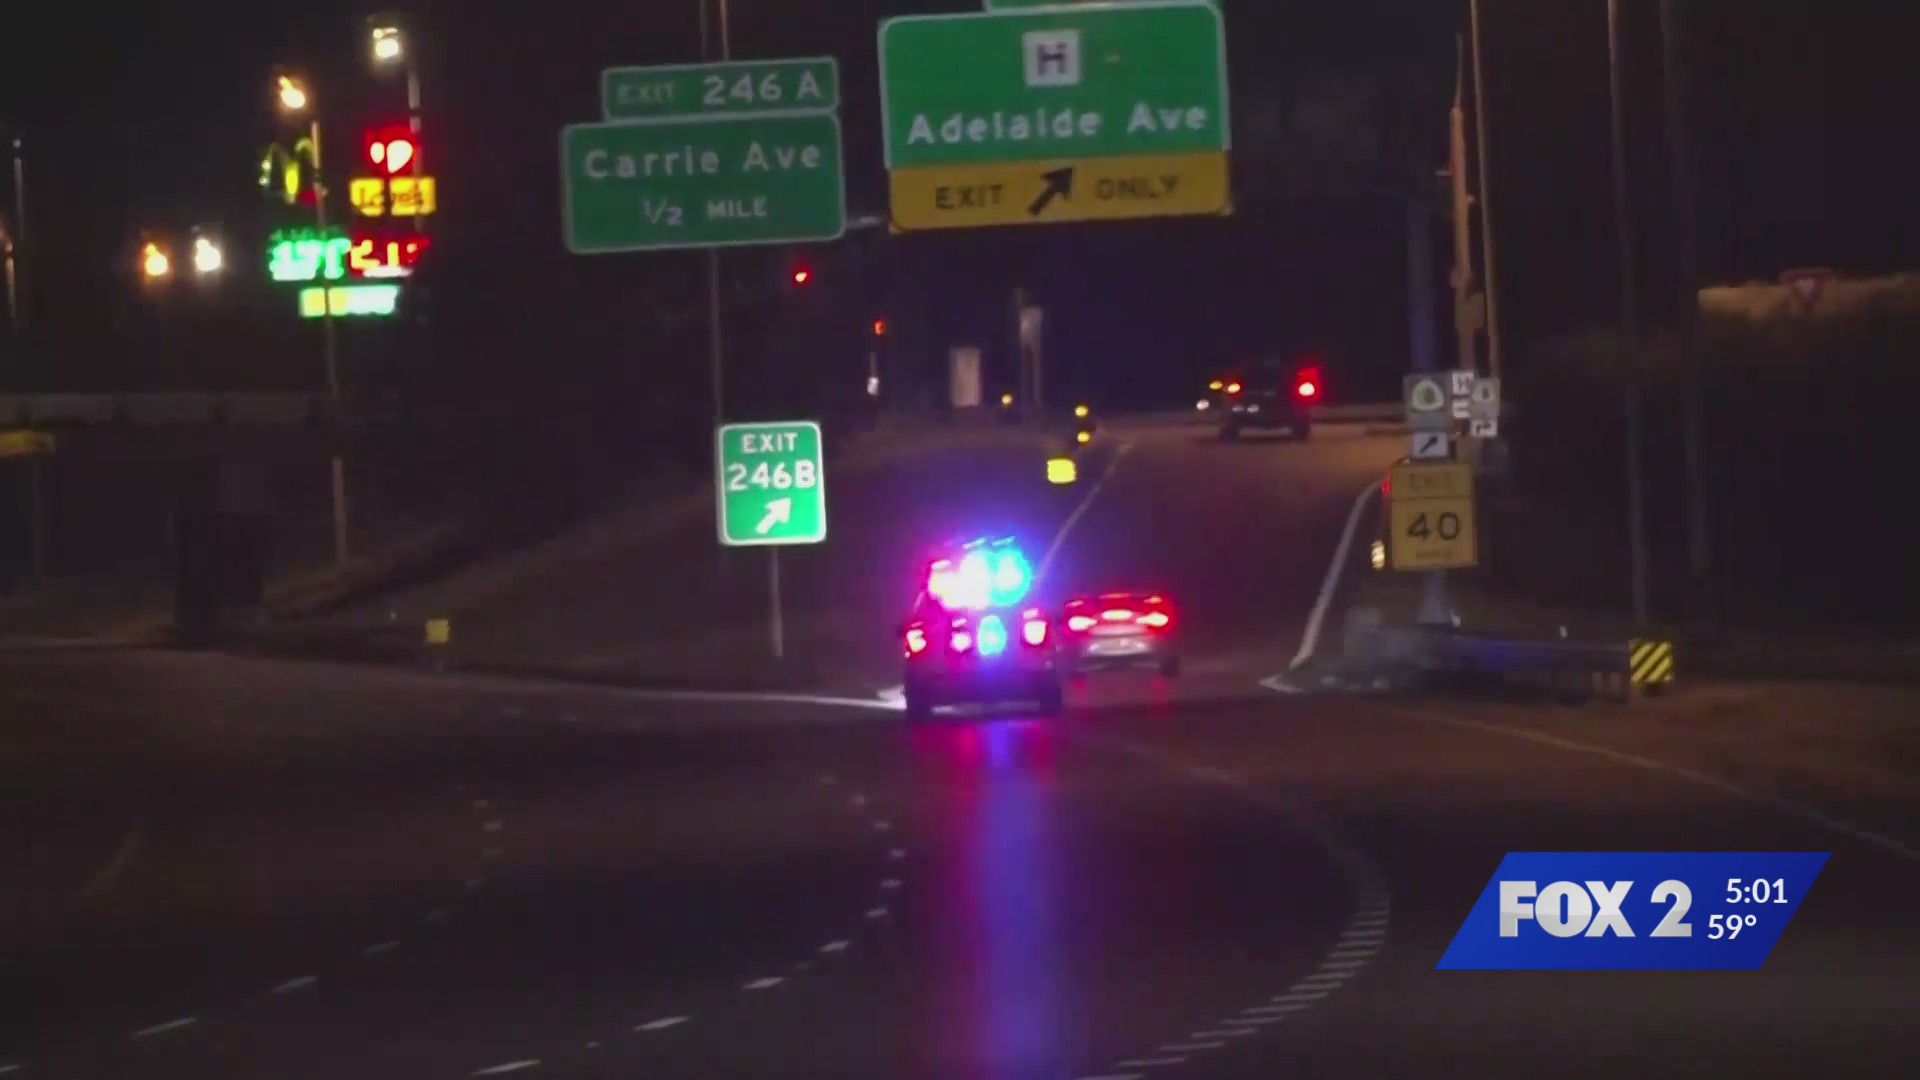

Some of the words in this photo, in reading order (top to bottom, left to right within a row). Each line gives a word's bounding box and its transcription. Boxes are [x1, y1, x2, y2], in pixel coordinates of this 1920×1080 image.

[1036, 41, 1068, 76] H
[616, 82, 677, 105] EXIT
[702, 74, 783, 106] 246
[796, 70, 822, 99] A
[906, 107, 1103, 145] Adelaide
[1126, 102, 1209, 134] Ave
[584, 144, 721, 178] Carrie
[742, 141, 822, 172] Ave
[706, 196, 769, 220] MILE
[934, 183, 1004, 211] EXIT
[1095, 174, 1181, 201] ONLY
[742, 431, 799, 455] EXIT
[727, 458, 817, 492] 246B
[1407, 511, 1462, 541] 40
